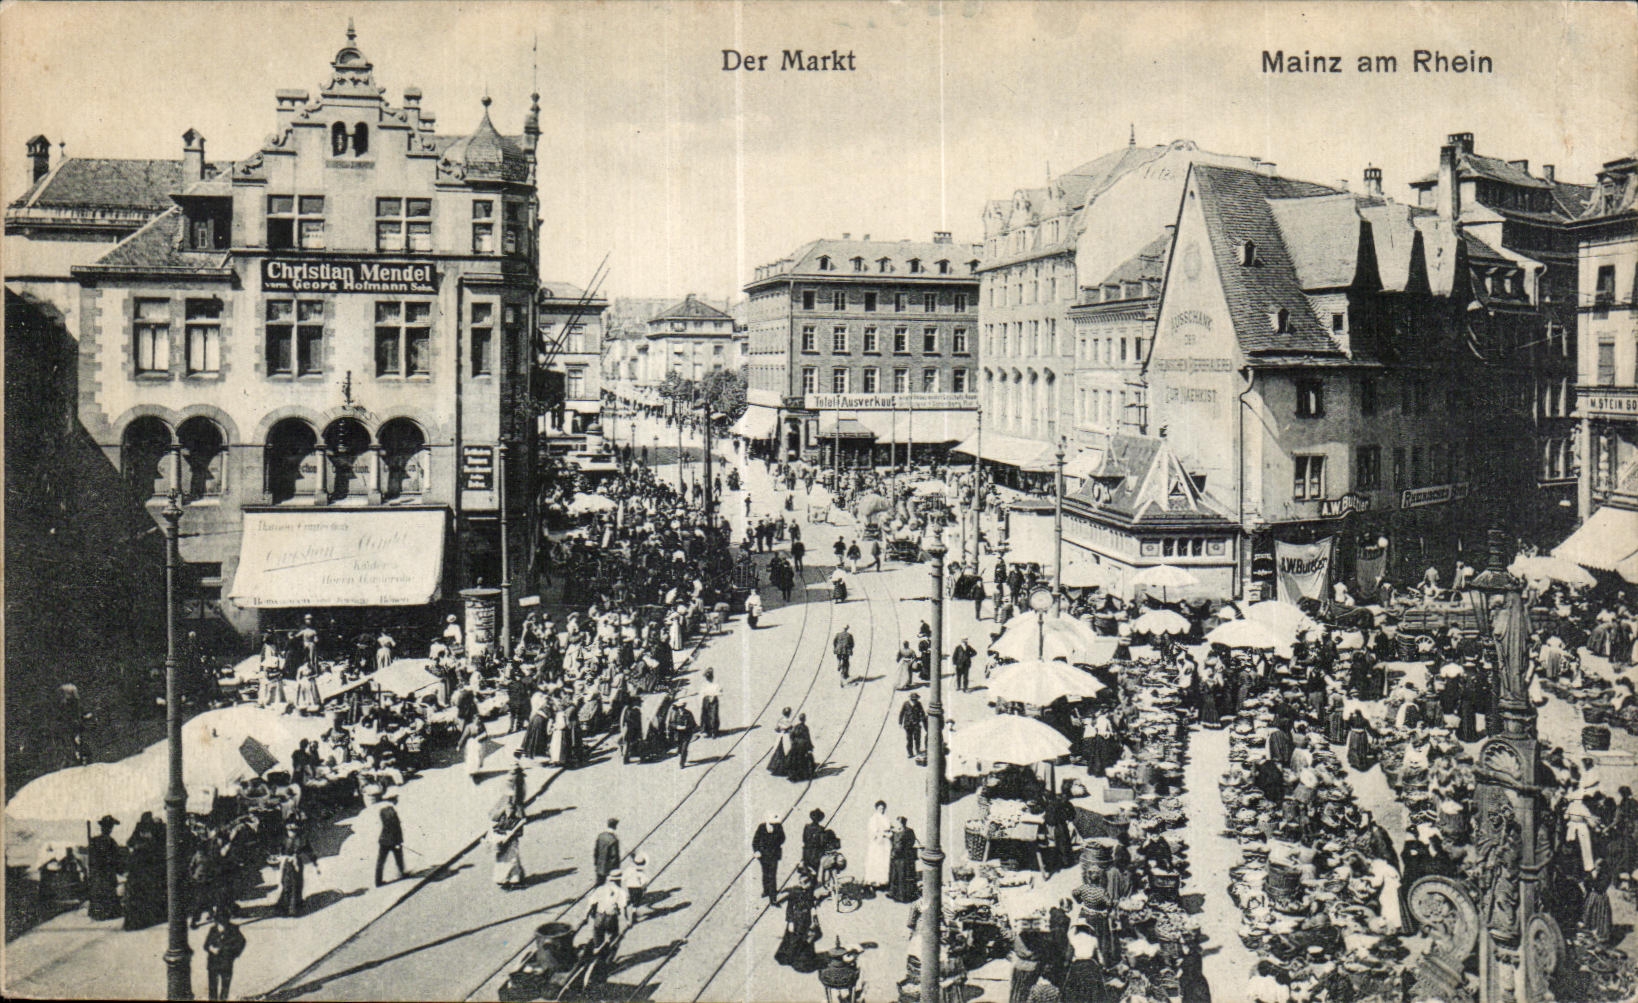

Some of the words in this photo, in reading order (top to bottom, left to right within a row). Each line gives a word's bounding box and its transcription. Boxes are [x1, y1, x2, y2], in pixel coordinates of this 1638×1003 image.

[267, 261, 354, 281] Christian
[360, 263, 431, 282] Mendel
[292, 278, 338, 291] Georg
[343, 280, 408, 291] Hofmann
[1171, 310, 1213, 335] AUSSCHANK
[1599, 398, 1623, 409] STEIN
